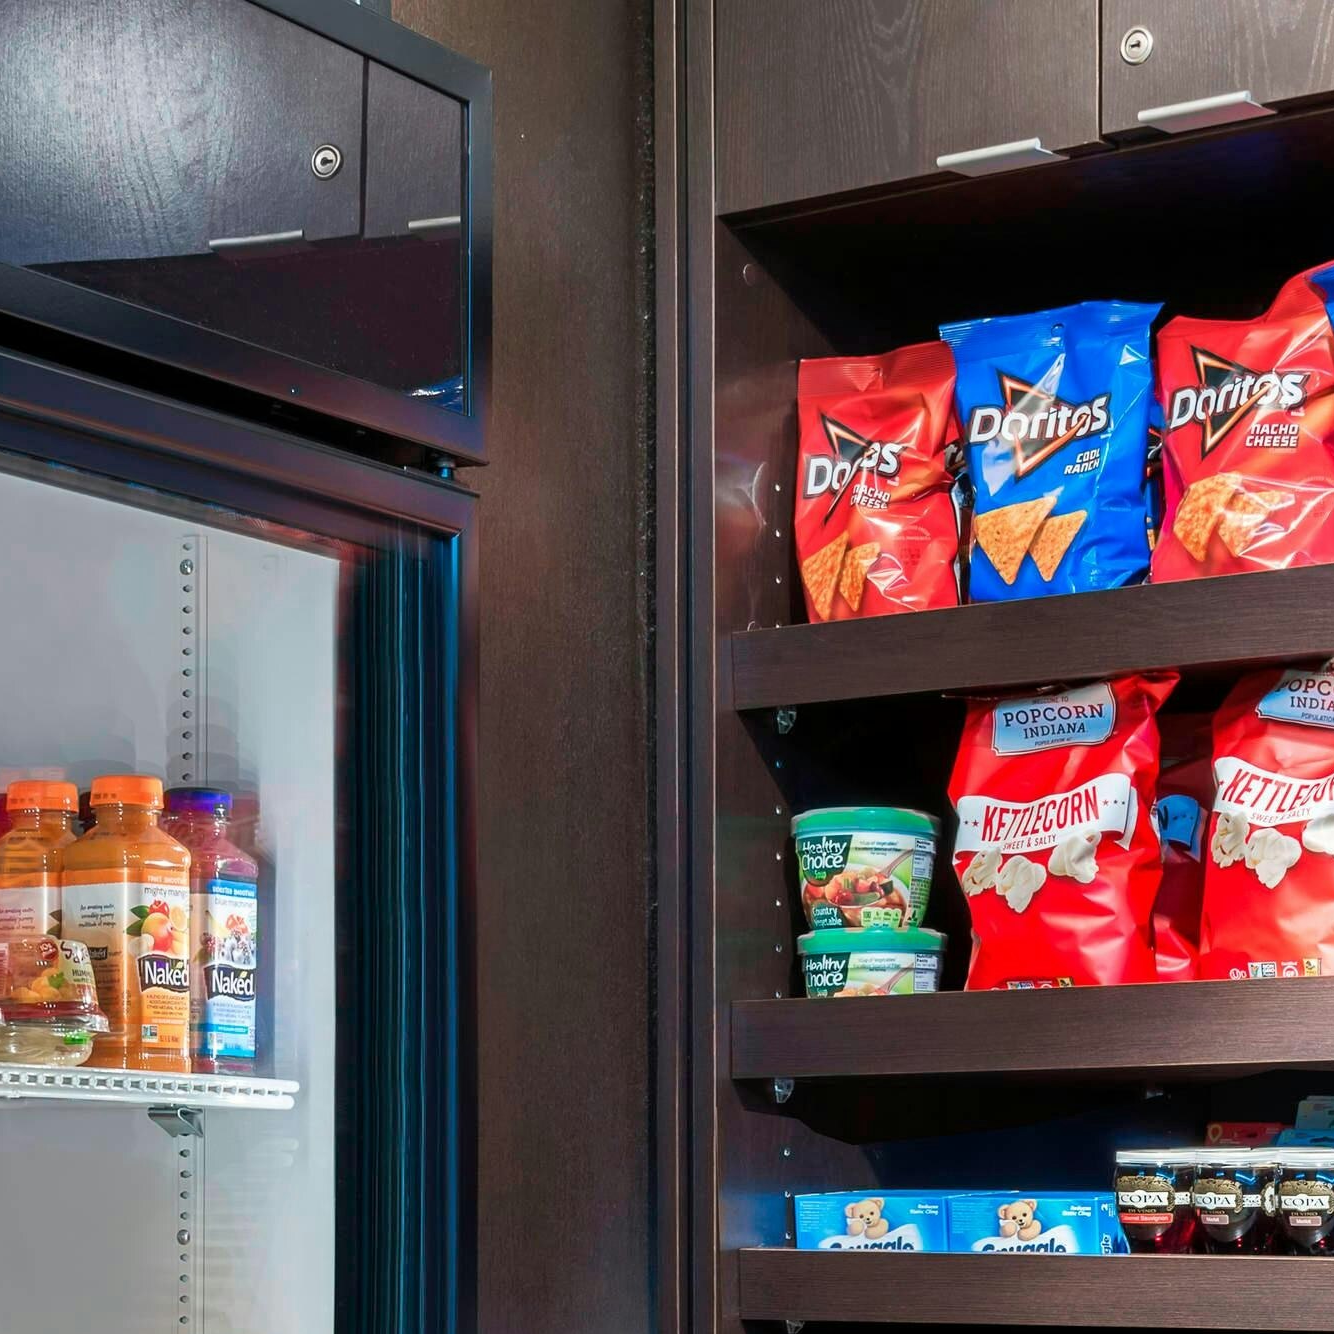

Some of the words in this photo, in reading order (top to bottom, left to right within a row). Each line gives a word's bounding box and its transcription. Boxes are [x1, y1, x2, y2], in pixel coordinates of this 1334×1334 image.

[1170, 372, 1309, 430] Doritos
[970, 394, 1110, 443] Doritos
[1250, 423, 1300, 436] NACHO
[1245, 434, 1300, 448] CHEESE
[1075, 448, 1101, 463] COOL
[804, 441, 902, 498] Doos
[1064, 458, 1101, 475] RANCH
[1003, 703, 1105, 728] POPCORN
[1023, 722, 1087, 740] INDIANA
[980, 785, 1100, 842] KETTLECORN
[802, 836, 848, 857] Healthy
[1002, 839, 1025, 851] SWEET
[1034, 834, 1057, 846] SALTY
[801, 852, 845, 871] Choice
[144, 959, 190, 986] Naked
[805, 955, 846, 974] Healthy
[211, 970, 255, 996] Naked
[806, 969, 845, 988] Choice
[1120, 1194, 1164, 1204] COPA
[1283, 1197, 1325, 1207] COPA
